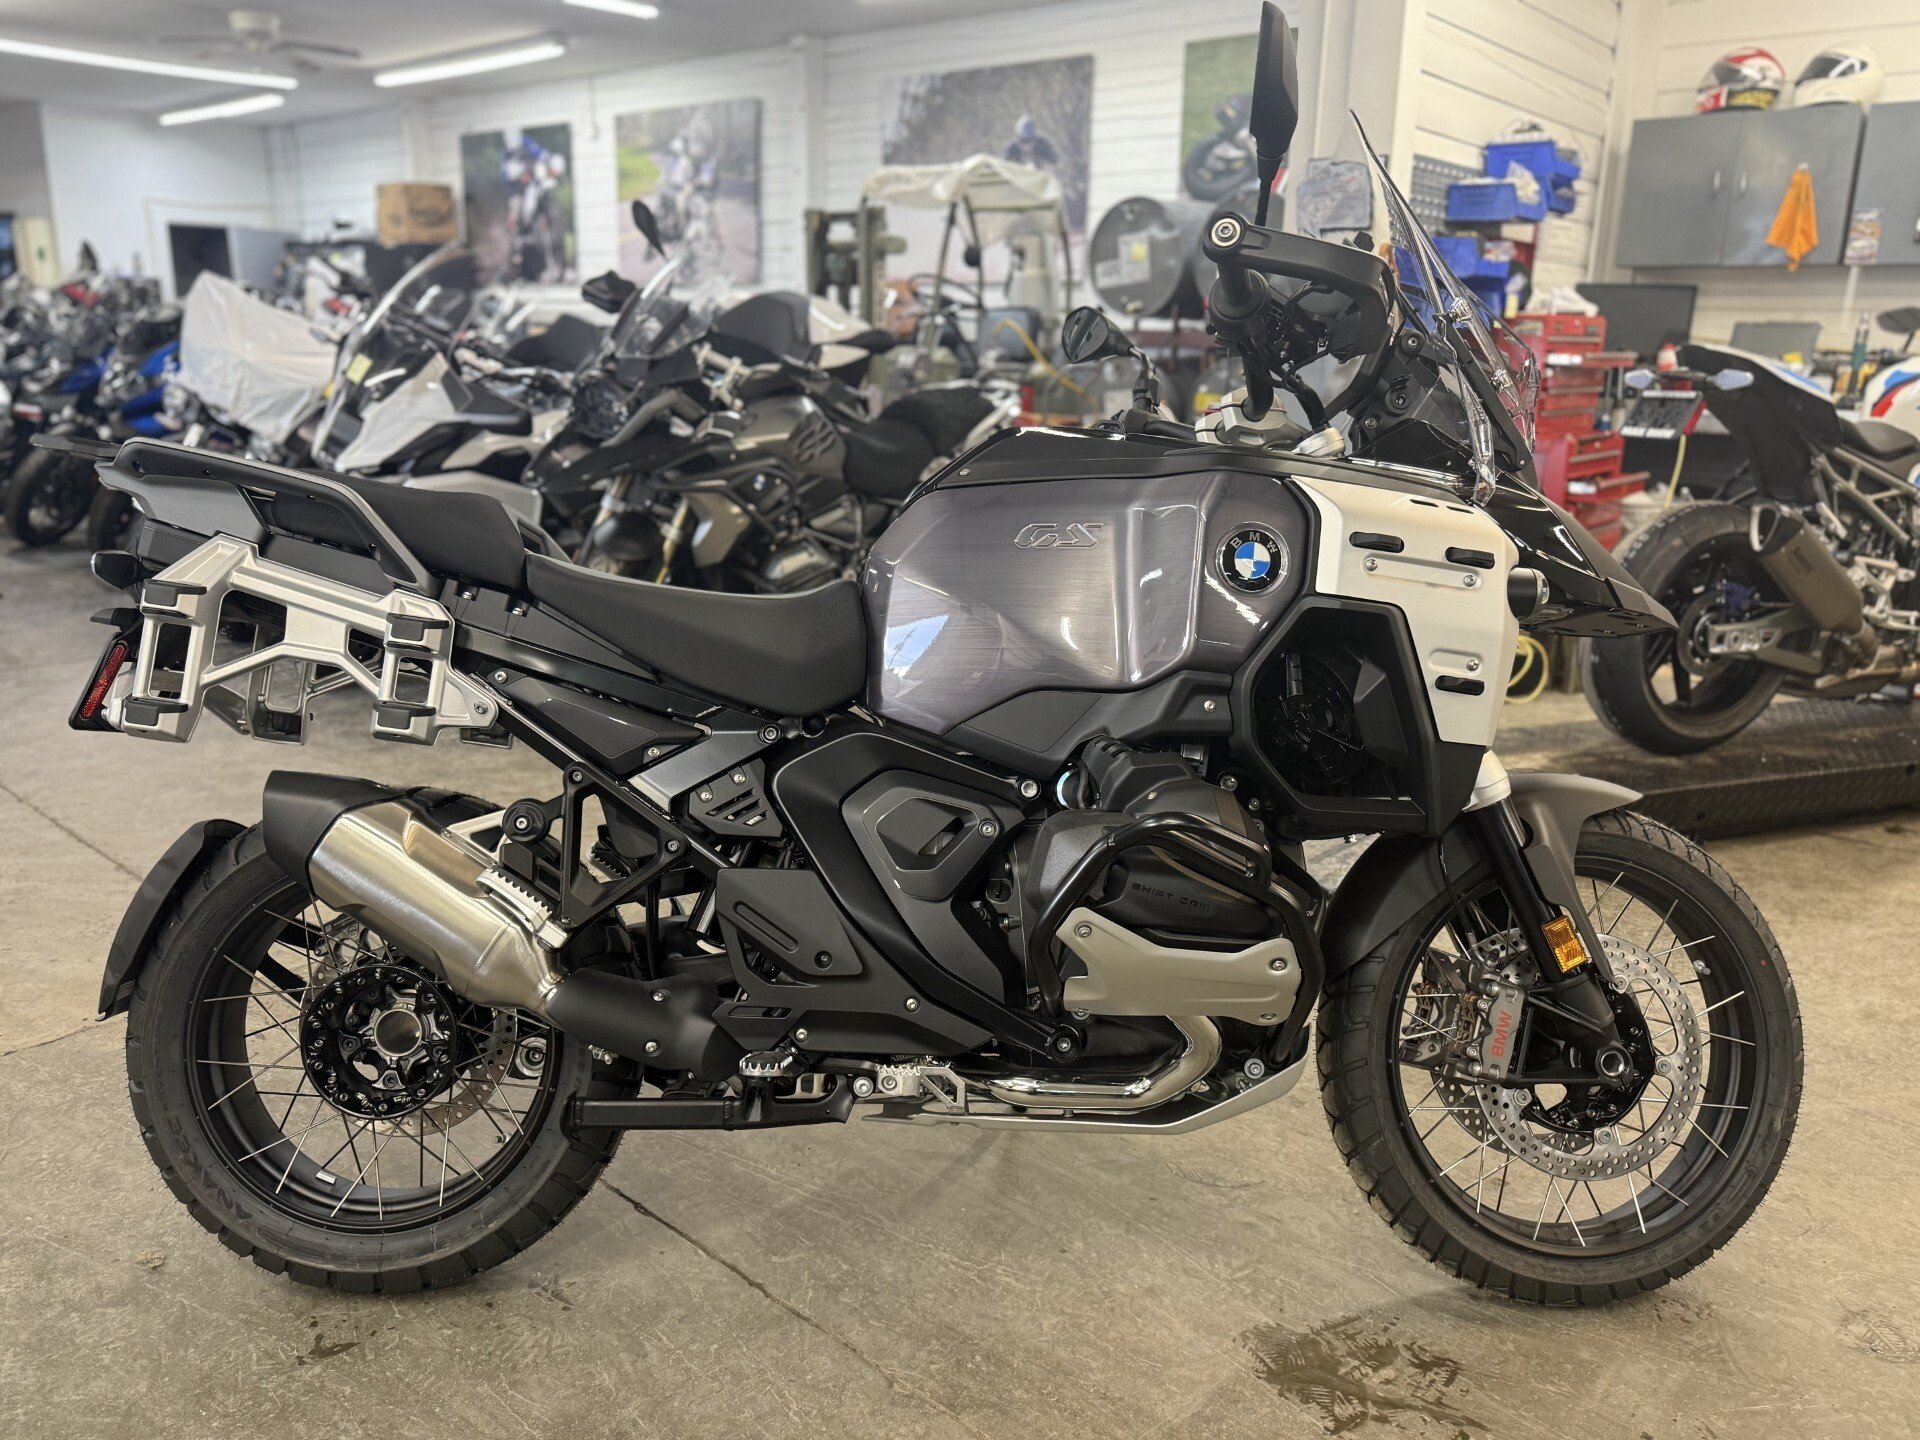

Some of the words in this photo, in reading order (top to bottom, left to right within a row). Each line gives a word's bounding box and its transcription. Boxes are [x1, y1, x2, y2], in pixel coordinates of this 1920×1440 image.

[1014, 522, 1104, 549] GS
[1229, 531, 1278, 553] BMW
[1130, 882, 1175, 900] SHIFT
[1180, 896, 1214, 913] CAM
[1491, 1010, 1513, 1057] BMW
